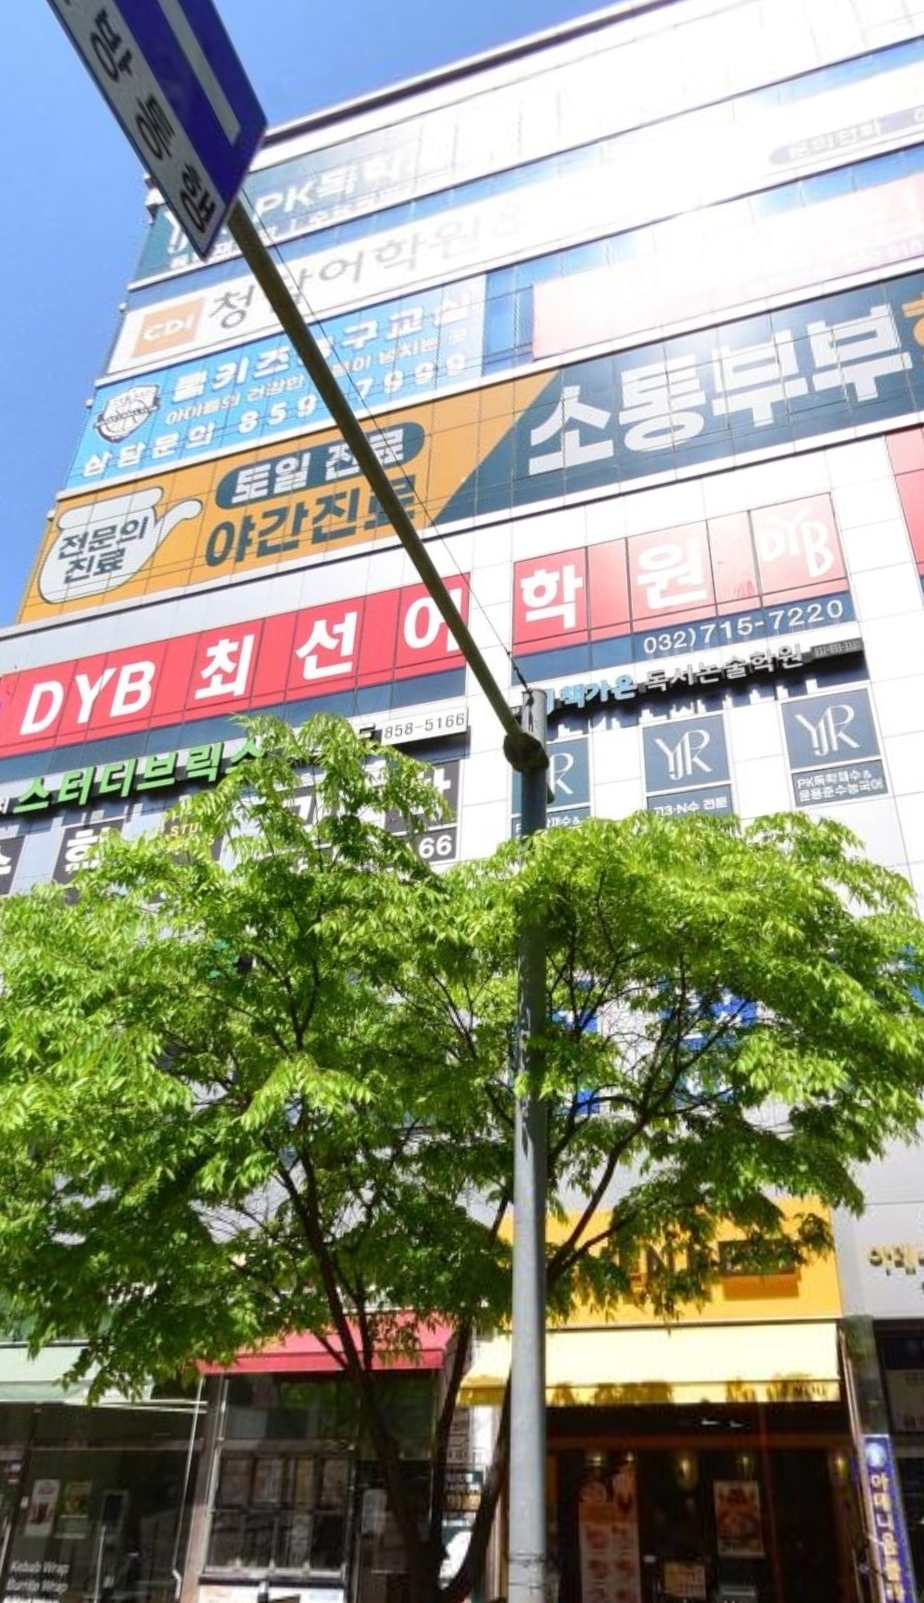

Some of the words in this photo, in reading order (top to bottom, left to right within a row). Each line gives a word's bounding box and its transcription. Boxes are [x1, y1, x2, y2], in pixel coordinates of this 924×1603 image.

[64, 0, 217, 235] 방통행
[142, 318, 193, 343] CDI
[528, 293, 924, 476] 소통부부
[82, 422, 216, 477] 상담문의
[231, 451, 312, 504] 토일
[59, 515, 148, 560] 전문의
[65, 548, 126, 584] 진료
[20, 659, 156, 736] DYB
[756, 508, 835, 578] DYB
[642, 599, 844, 654] 032)715-7220
[646, 643, 803, 693] 독서논술학원
[384, 712, 465, 739] 858-5166
[13, 738, 267, 814] 스터디브릭스
